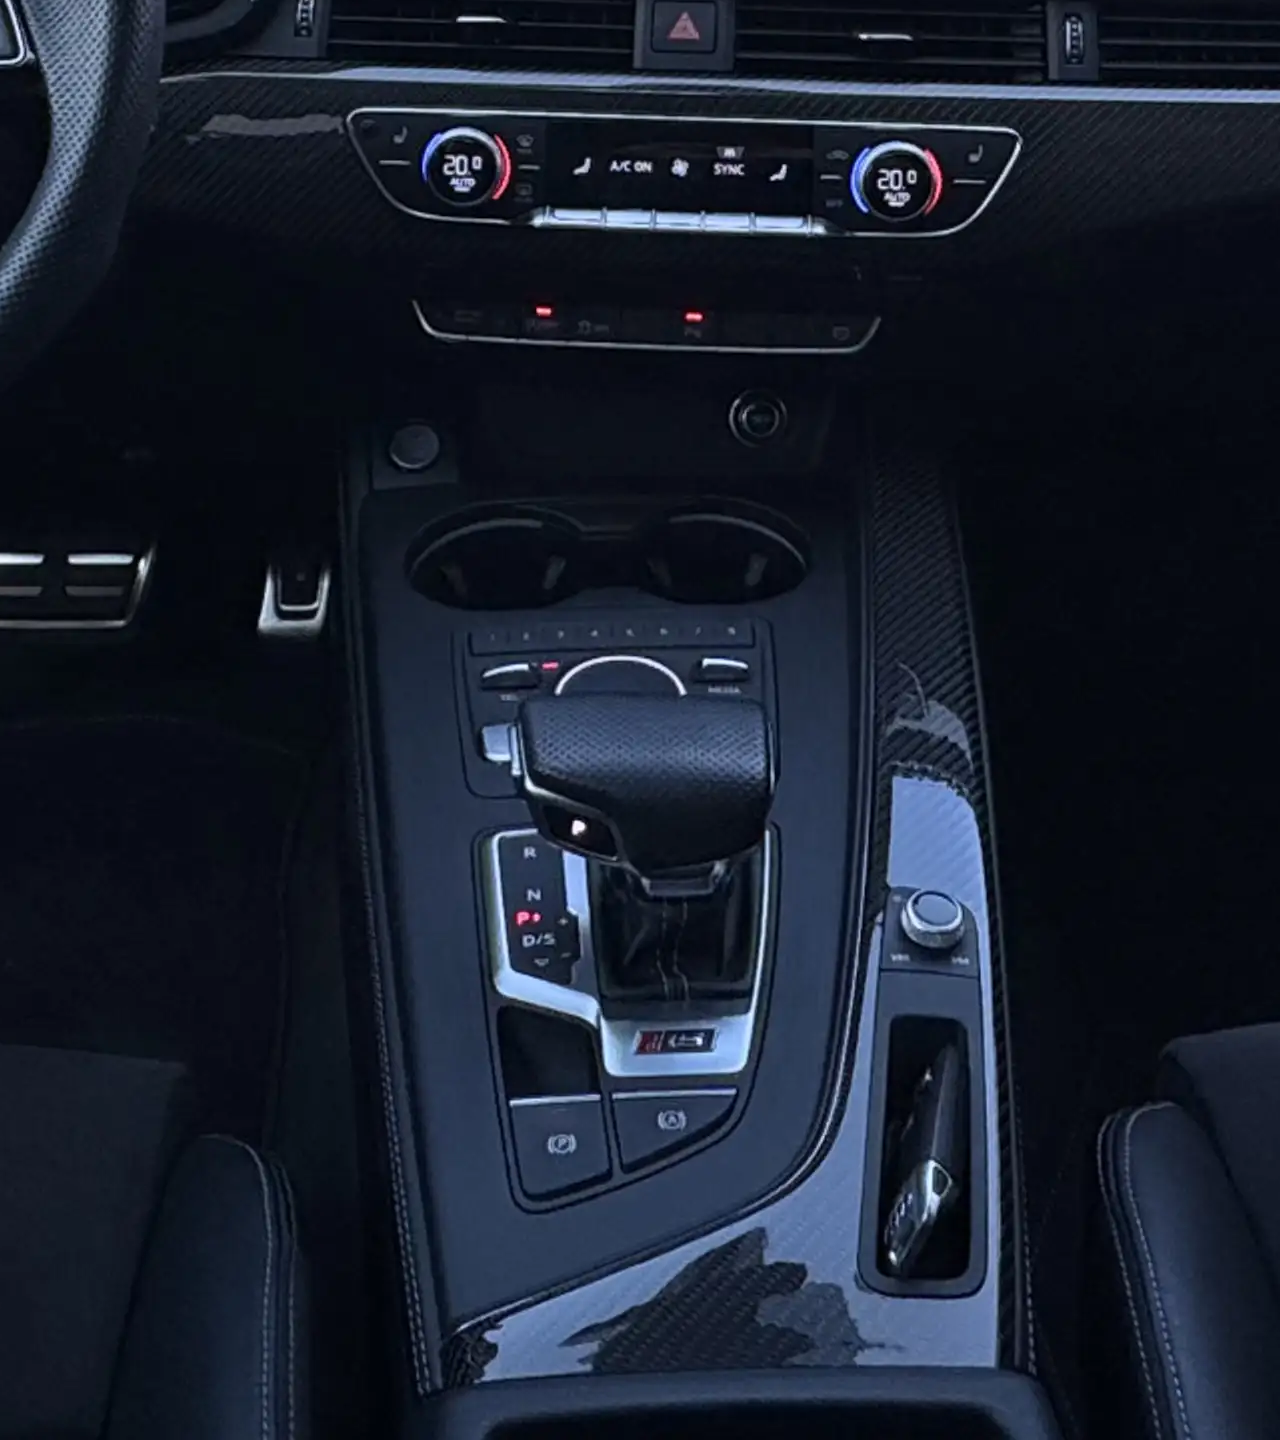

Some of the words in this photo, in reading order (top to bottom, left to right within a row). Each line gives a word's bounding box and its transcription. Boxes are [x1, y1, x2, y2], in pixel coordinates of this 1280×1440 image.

[609, 160, 633, 173] A/C
[634, 161, 654, 174] ON
[712, 162, 746, 177] SYNC
[571, 819, 587, 835] P
[523, 846, 537, 859] R
[527, 888, 542, 902] N
[515, 911, 531, 925] P
[521, 934, 557, 947] D/S
